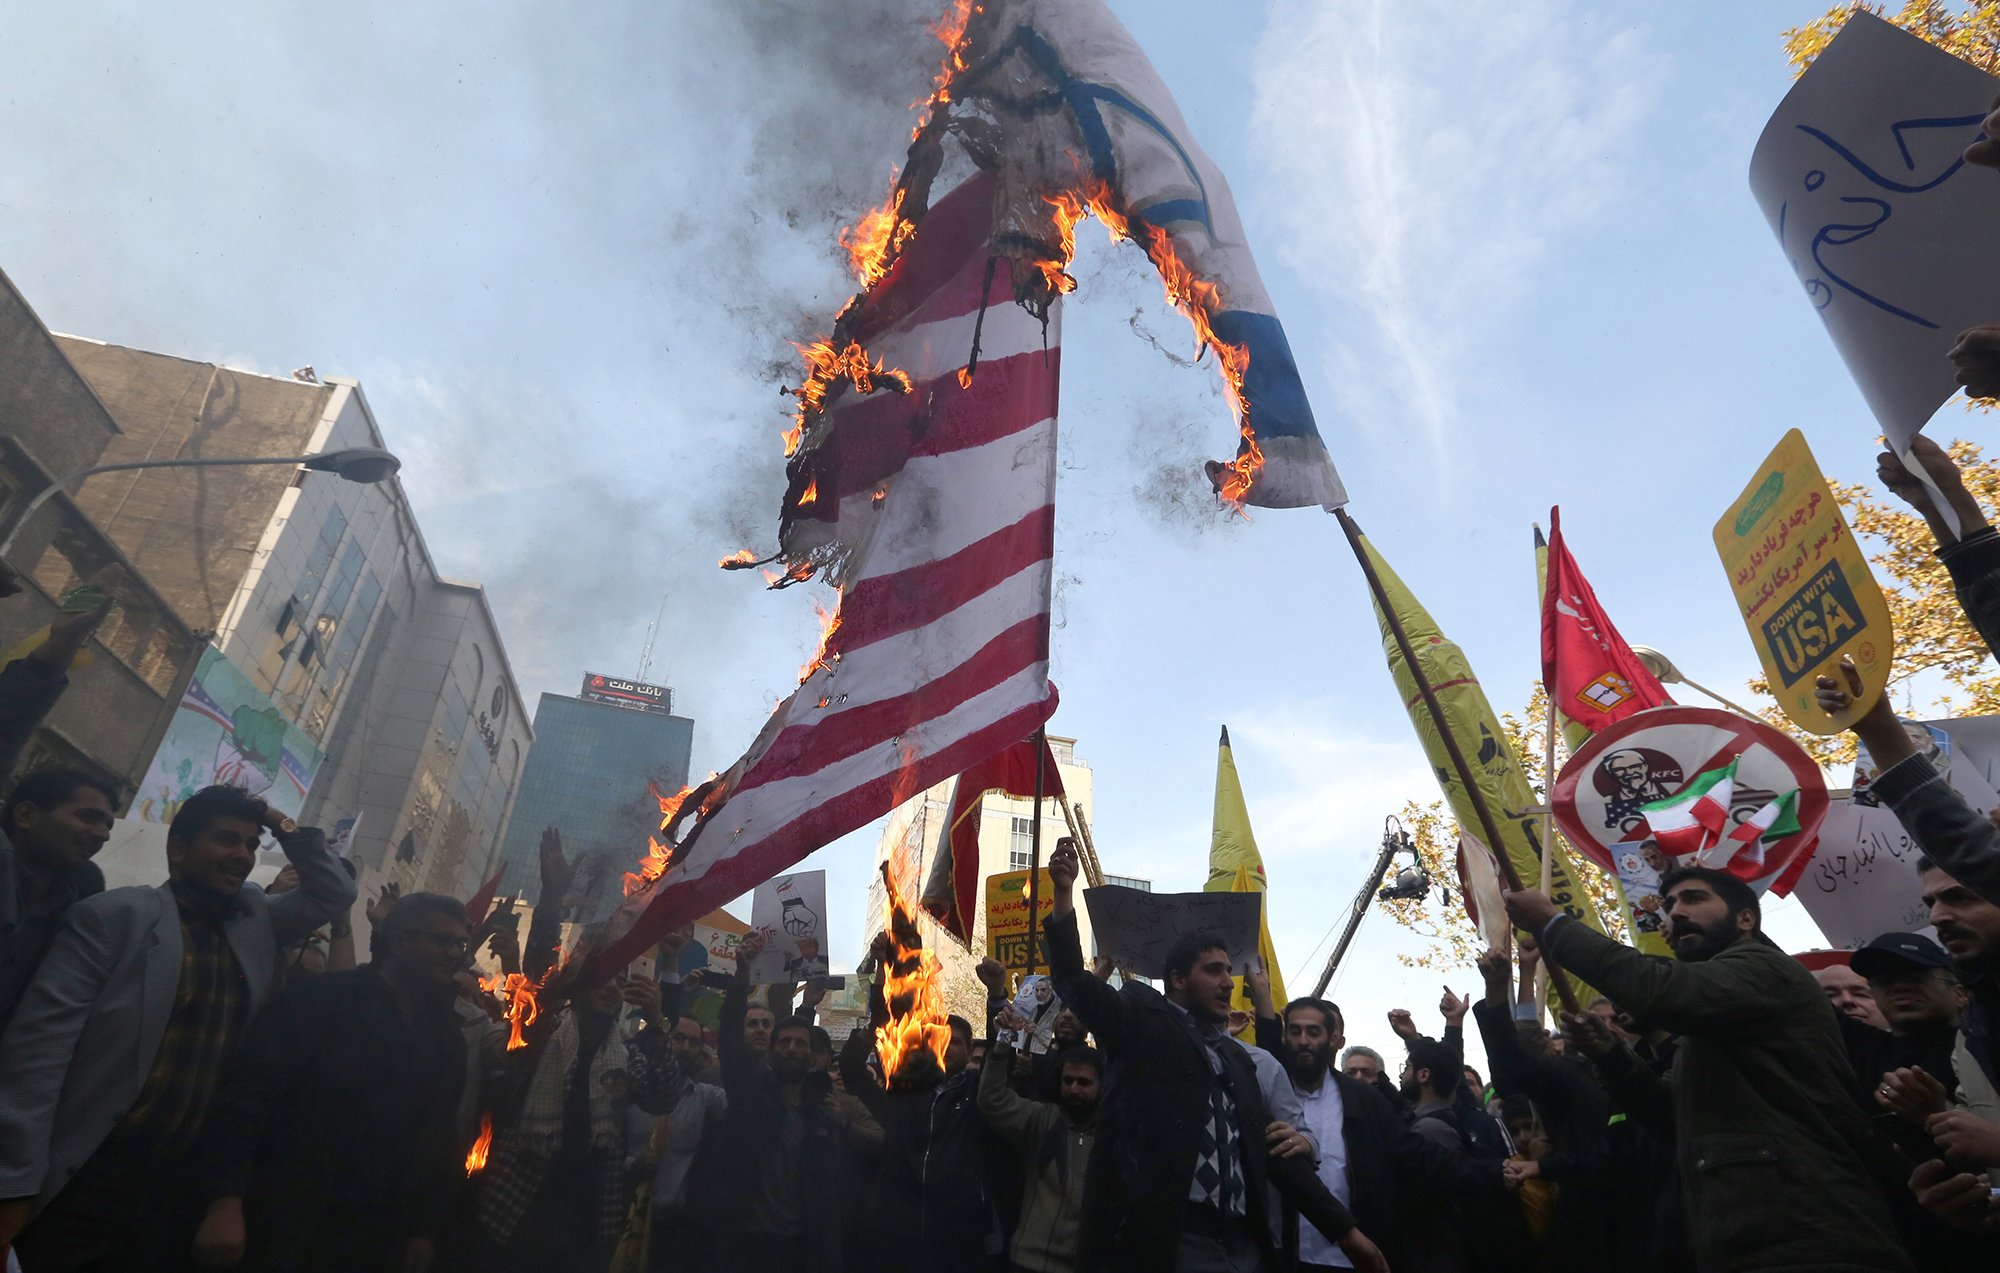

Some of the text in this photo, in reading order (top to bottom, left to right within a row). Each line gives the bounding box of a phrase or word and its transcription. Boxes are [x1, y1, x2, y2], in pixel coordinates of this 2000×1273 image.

[1789, 509, 1807, 529] چه
[1808, 491, 1821, 519] هر
[1762, 519, 1789, 557] فریاد
[1737, 551, 1763, 587] دارید
[1746, 517, 1844, 619] بر سر آمریکا بکشید
[1769, 569, 1836, 635] DOWN WITH
[1775, 591, 1856, 673] USA
[608, 679, 662, 700] بانک ملت
[1651, 769, 1680, 778] KFC
[1813, 855, 1859, 893] جهانی
[1000, 936, 1022, 945] DOWN
